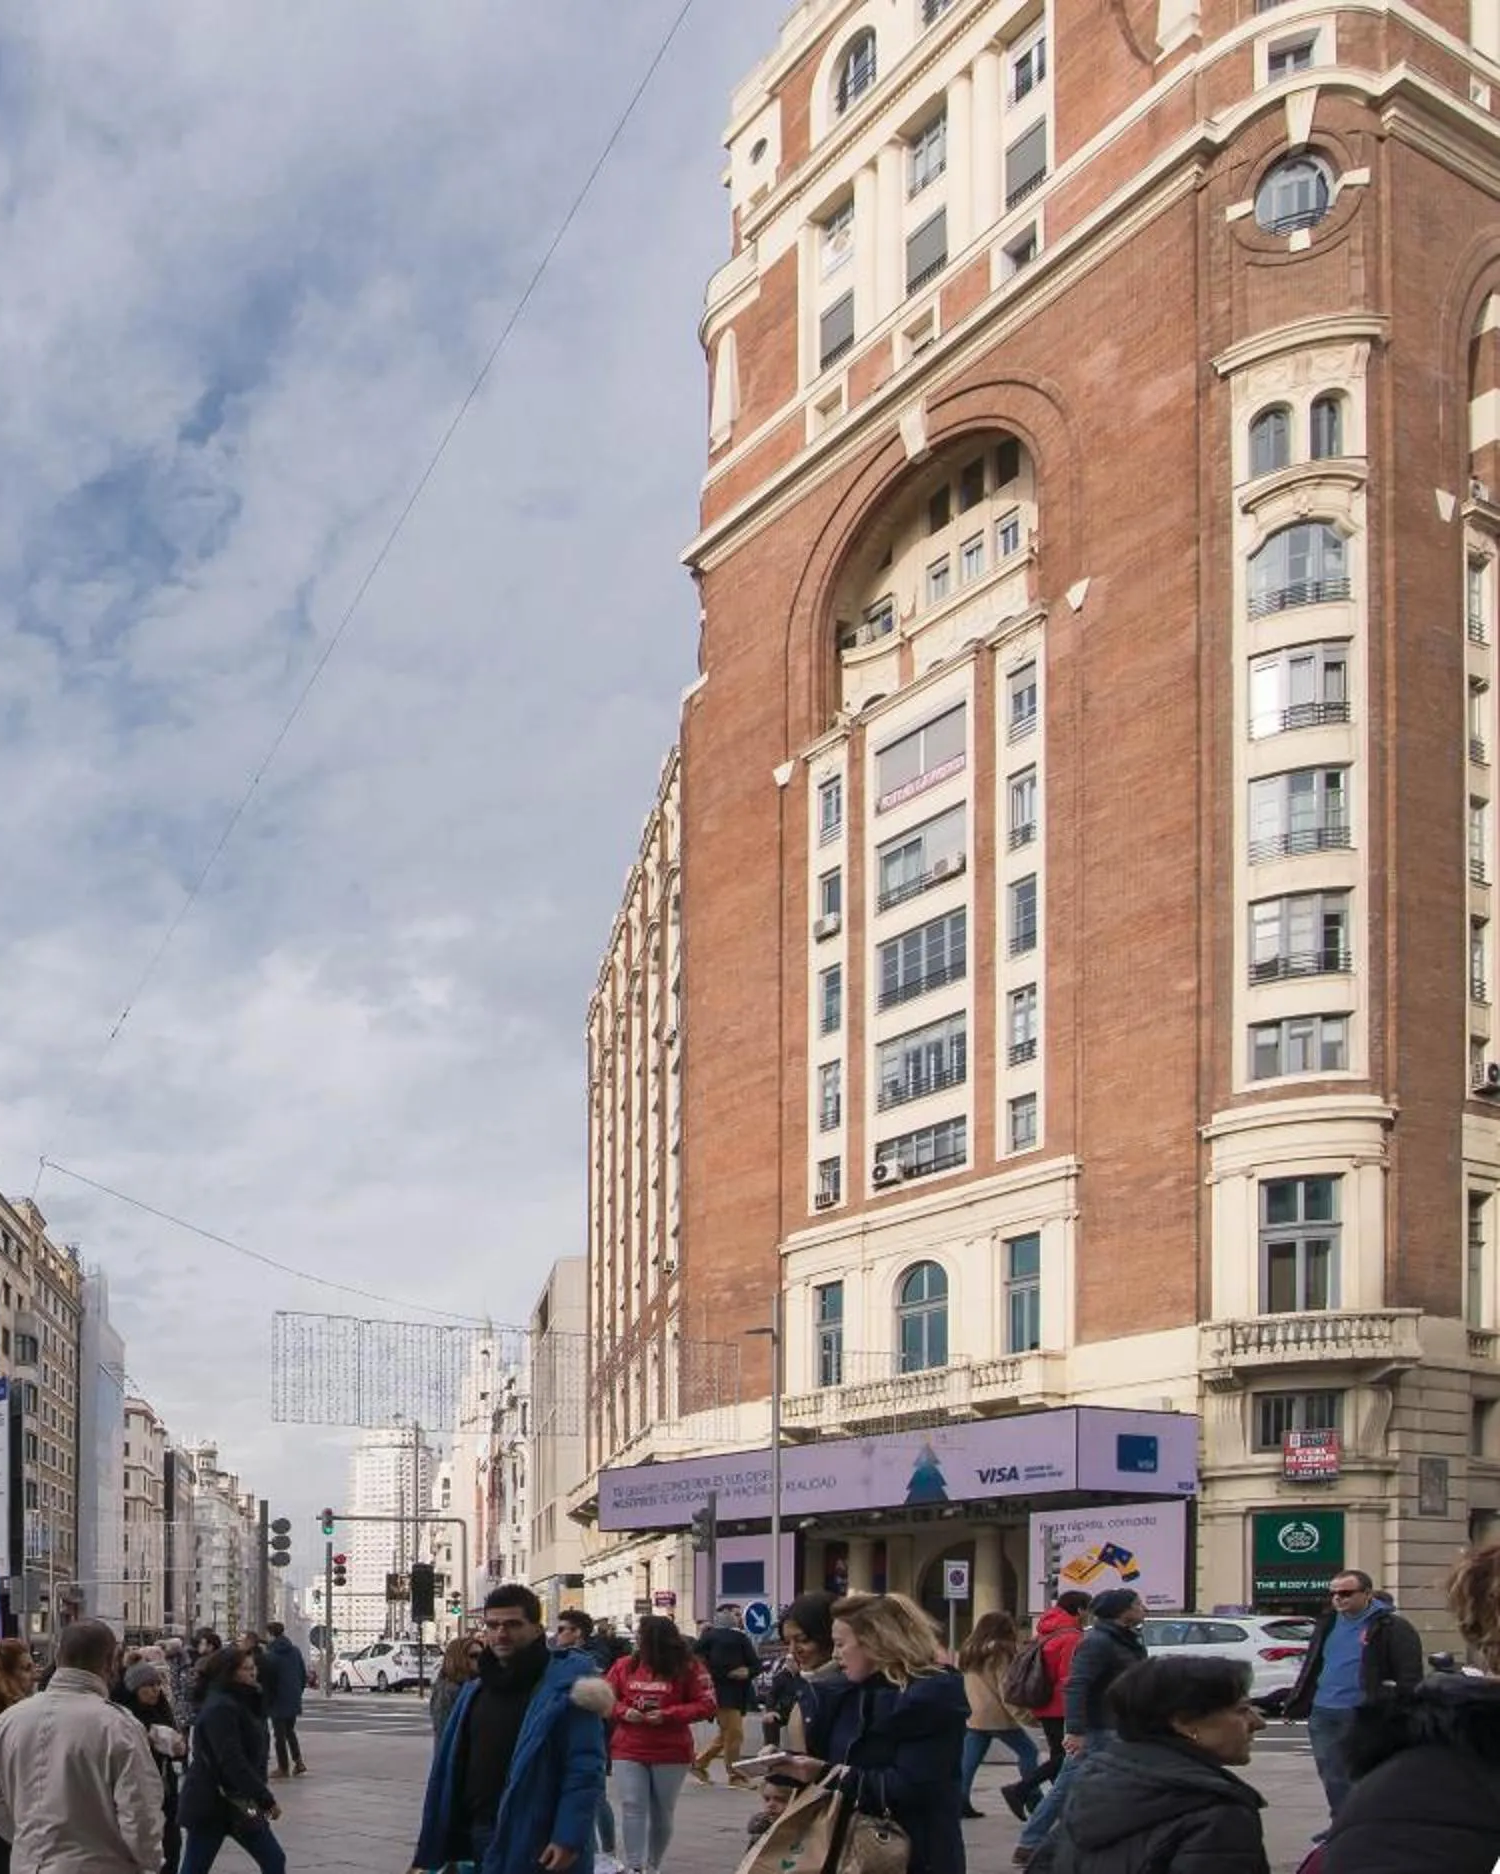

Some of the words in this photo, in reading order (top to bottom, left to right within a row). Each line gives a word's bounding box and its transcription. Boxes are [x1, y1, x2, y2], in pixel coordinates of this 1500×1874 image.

[975, 1464, 1020, 1484] VISA
[1255, 1581, 1276, 1589] THE
[1280, 1580, 1308, 1589] BODY
